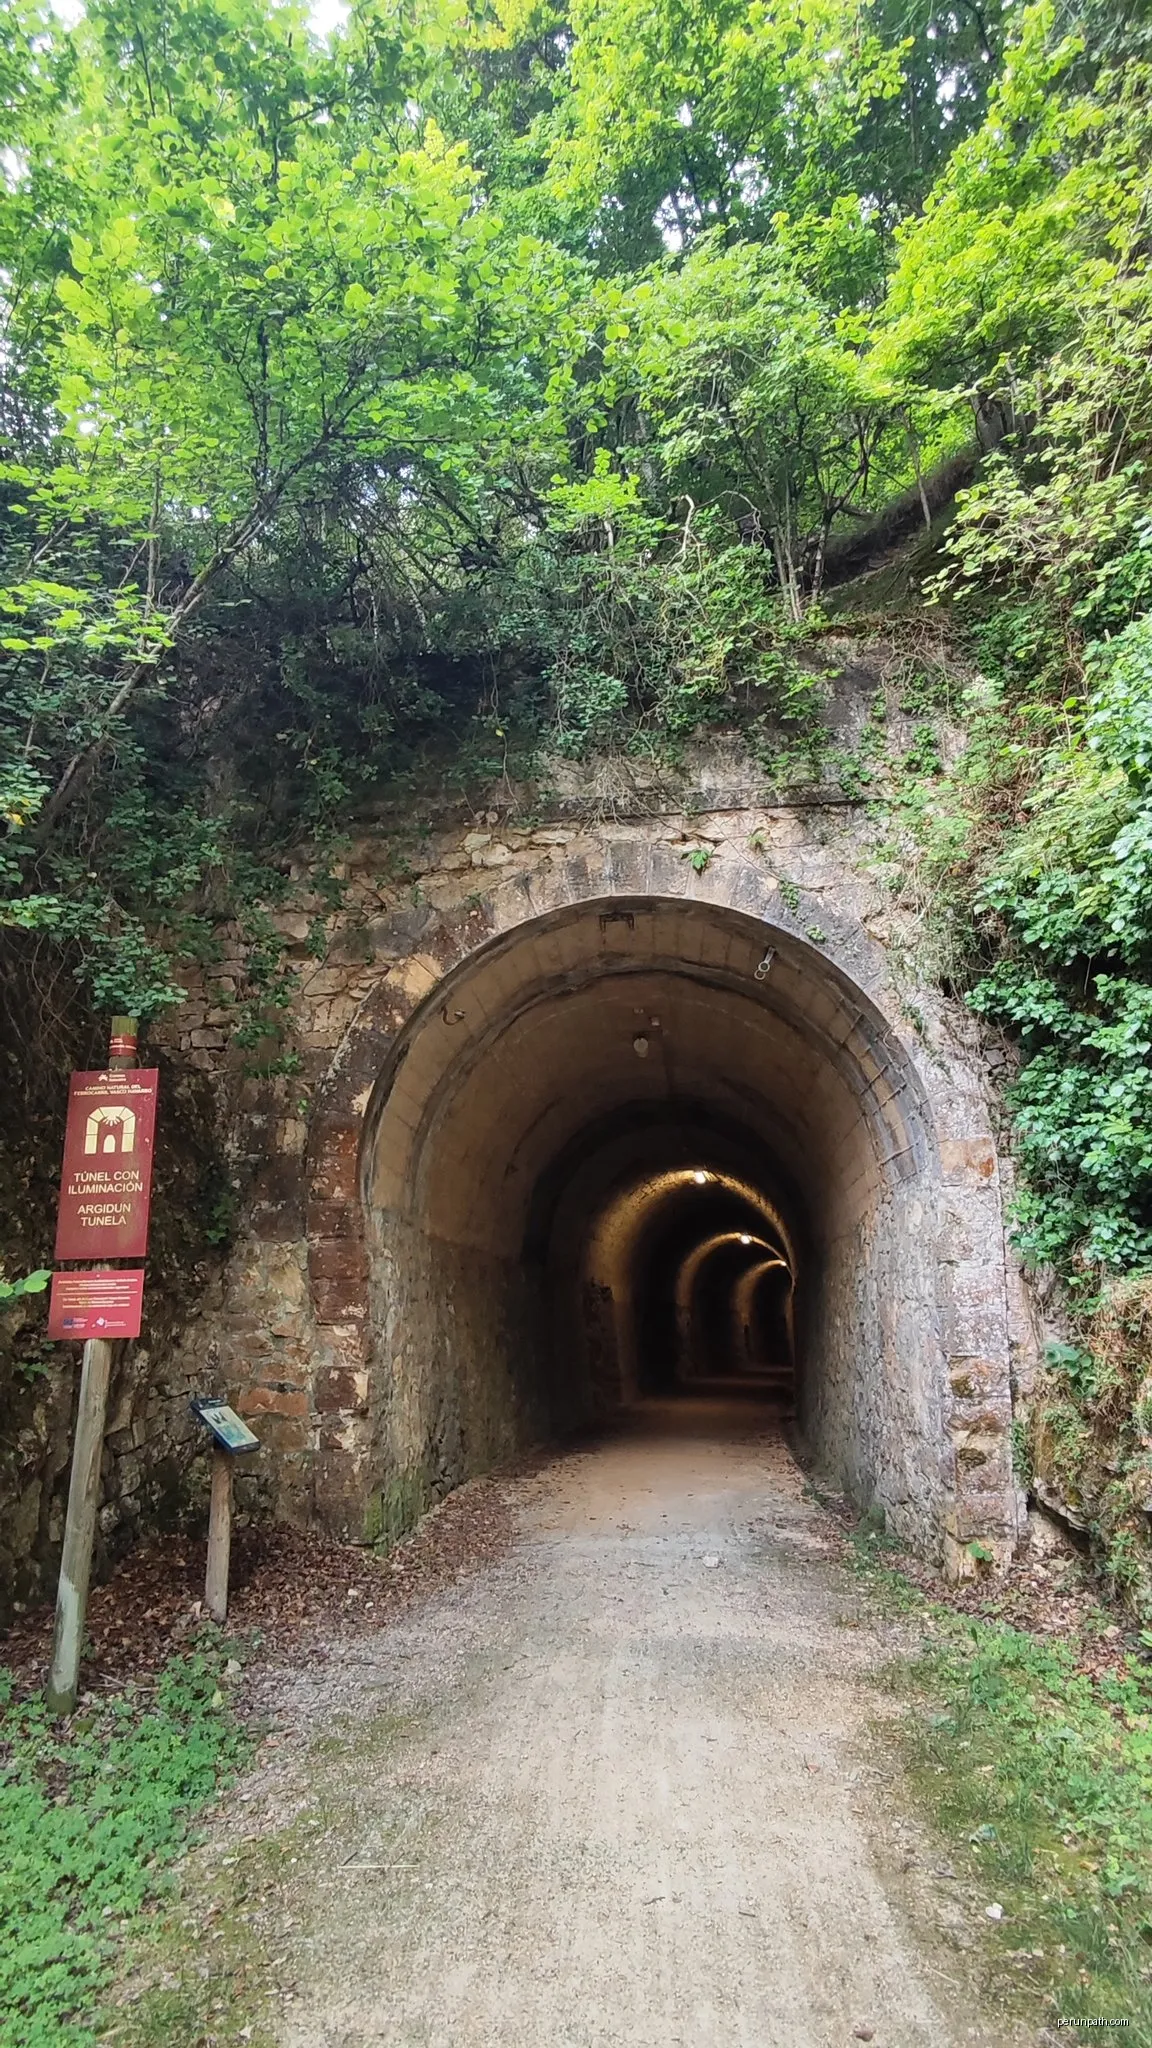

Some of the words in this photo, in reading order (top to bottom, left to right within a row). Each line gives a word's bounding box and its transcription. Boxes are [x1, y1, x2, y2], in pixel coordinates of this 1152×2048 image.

[74, 1170, 111, 1182] TÚNEL
[113, 1170, 140, 1181] CON
[68, 1181, 143, 1195] ILUMINACIÓN
[77, 1203, 131, 1215] ARGIDUN
[80, 1215, 126, 1227] TUNELA
